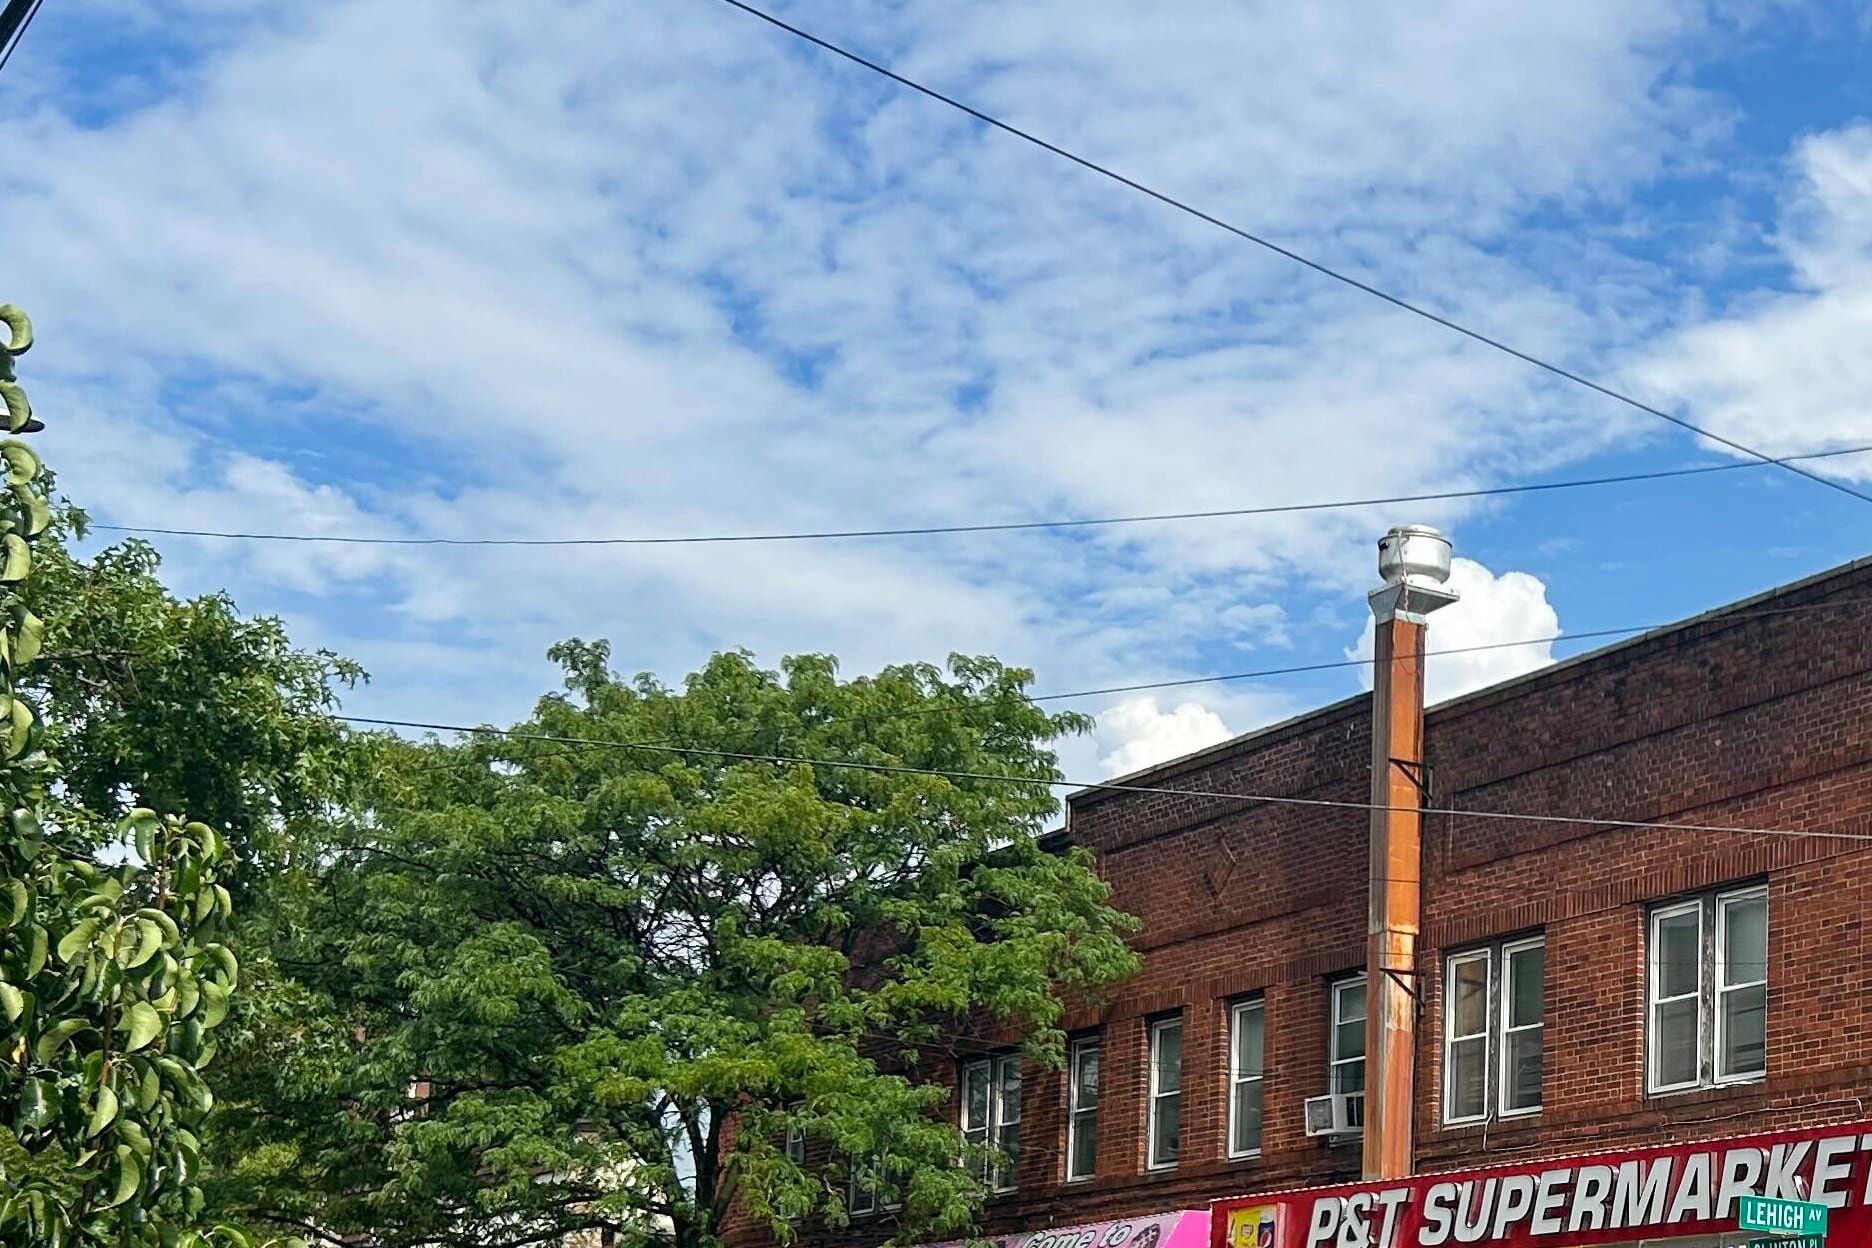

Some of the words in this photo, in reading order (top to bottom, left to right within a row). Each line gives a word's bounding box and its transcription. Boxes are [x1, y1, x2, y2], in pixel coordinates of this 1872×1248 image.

[1746, 1201, 1804, 1229] LEHIGH
[1808, 1208, 1822, 1222] AV
[1098, 1223, 1133, 1248] to
